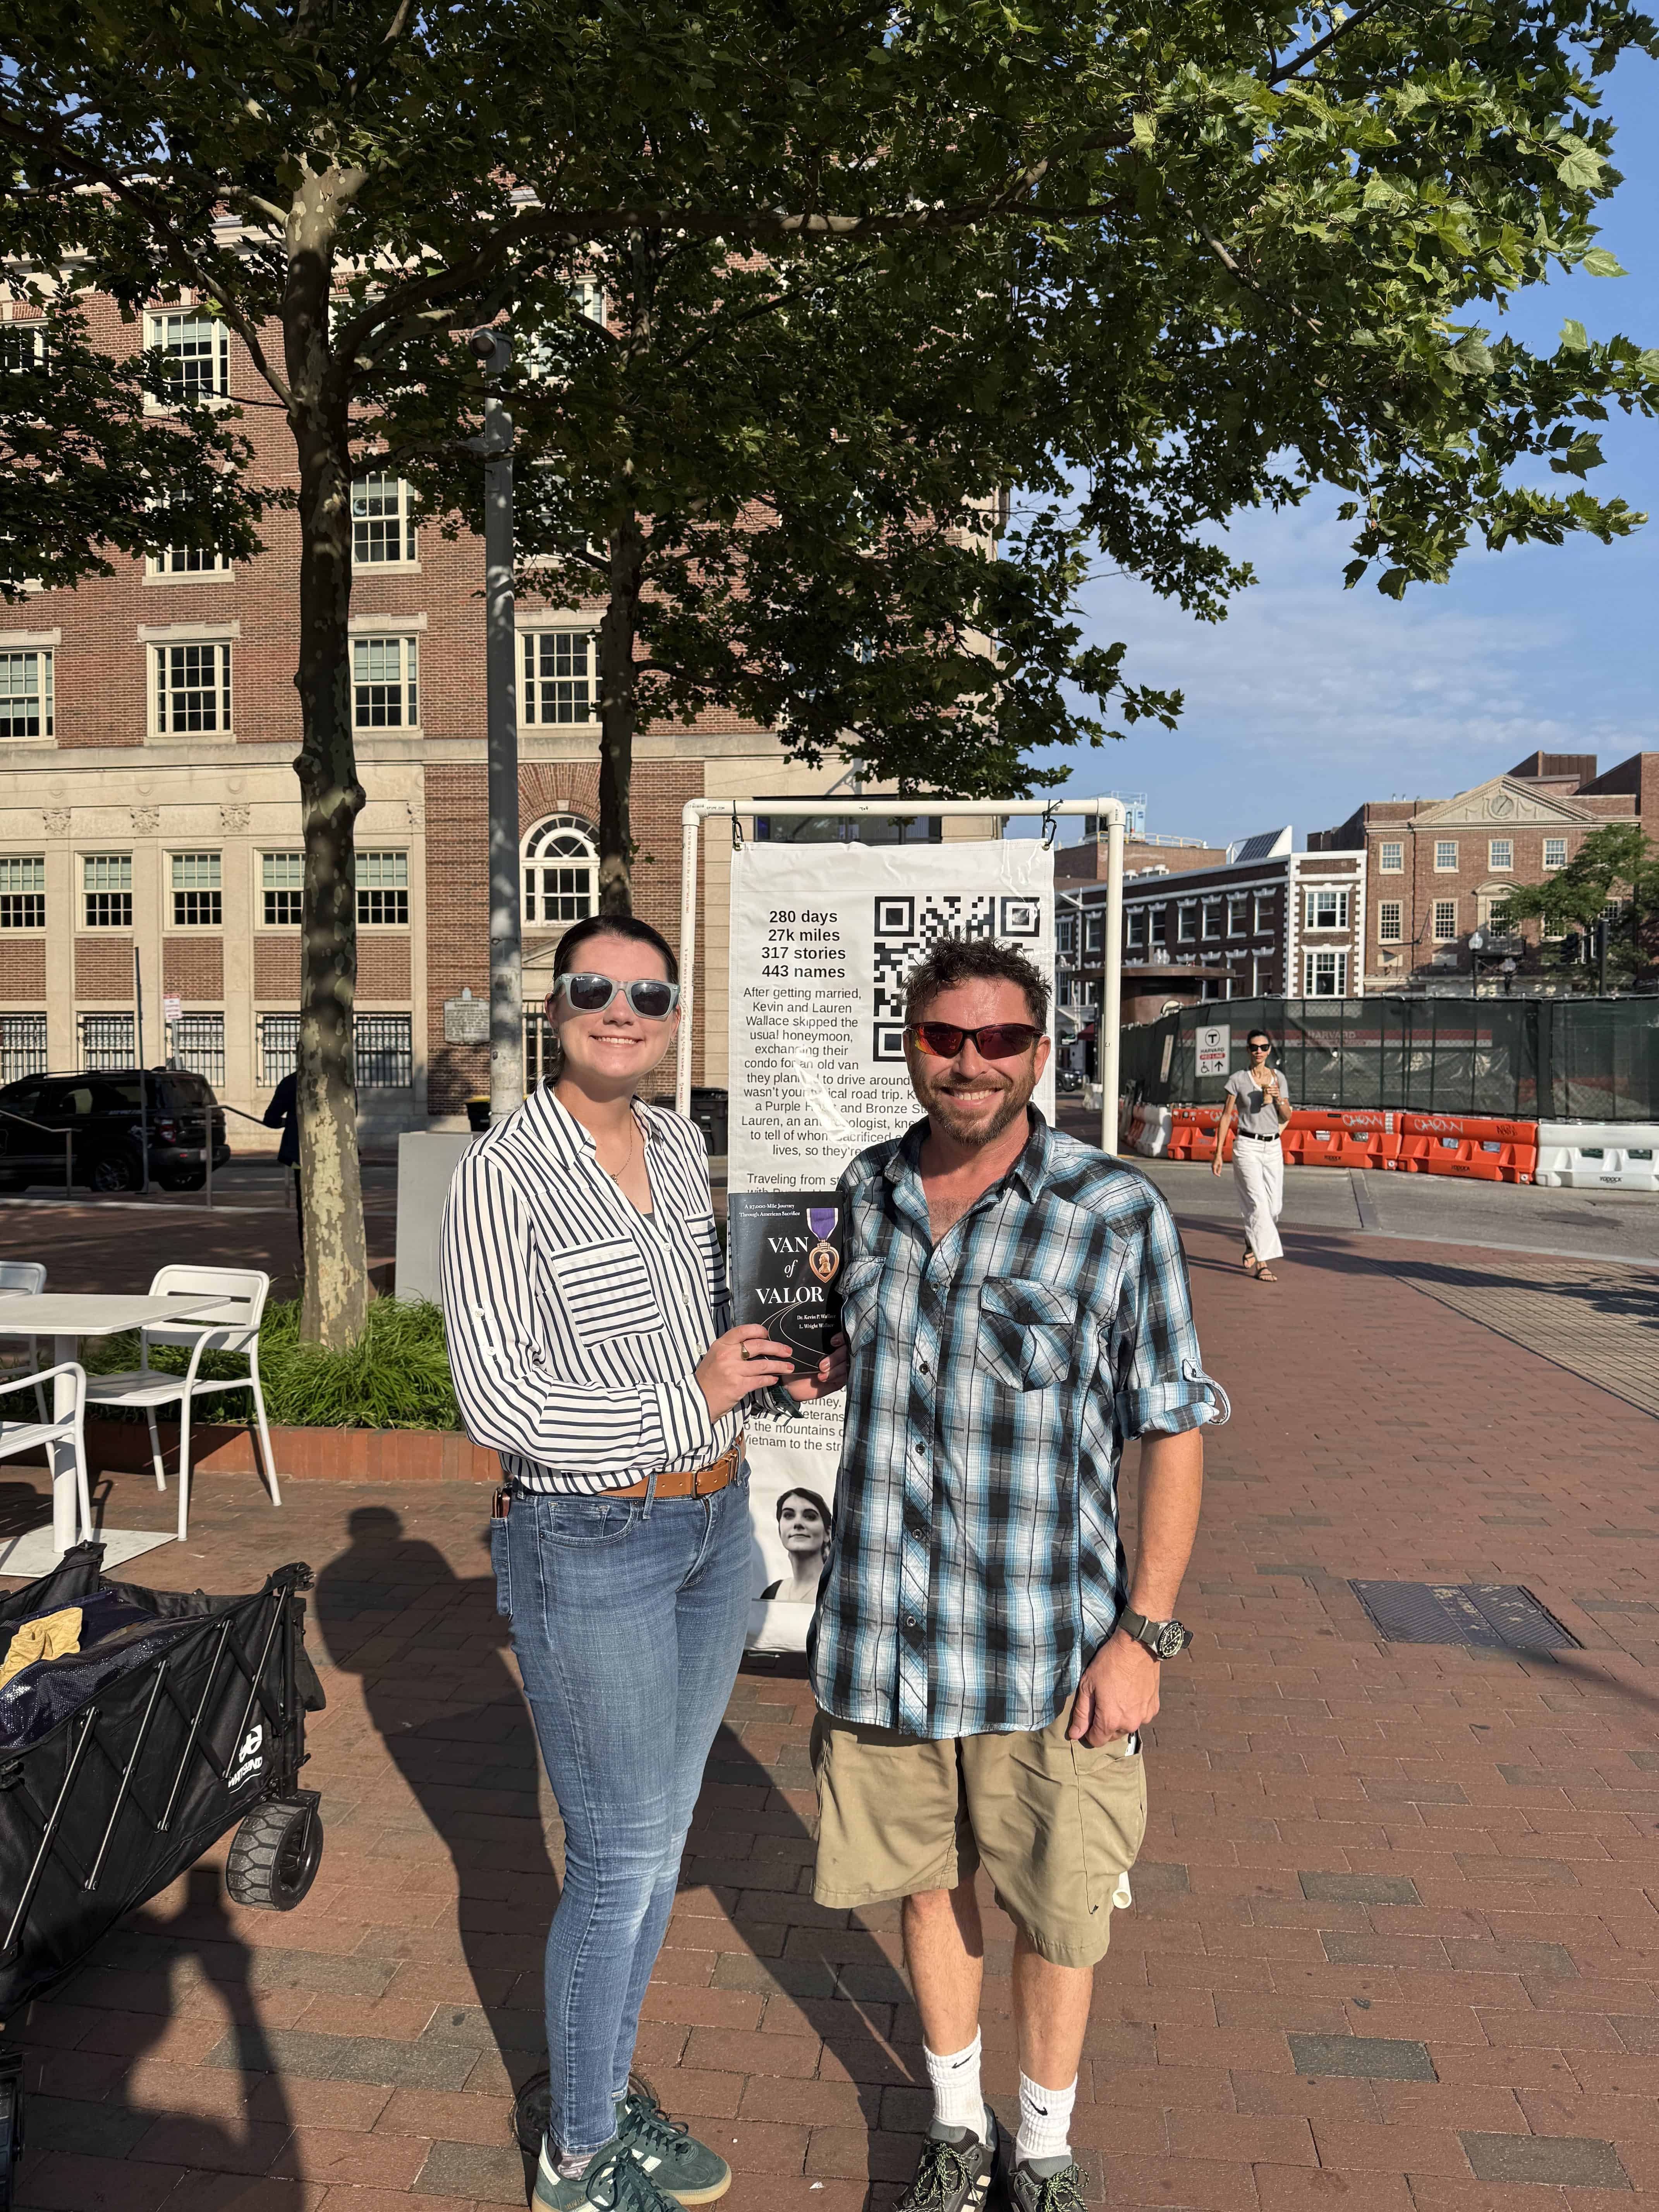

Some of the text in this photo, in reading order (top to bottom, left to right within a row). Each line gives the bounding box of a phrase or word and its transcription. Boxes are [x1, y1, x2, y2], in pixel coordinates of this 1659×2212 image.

[770, 910, 837, 926] 280 days
[768, 929, 840, 941] 27k miles
[762, 946, 845, 959] 317 stories
[762, 965, 845, 977] 443 names
[744, 987, 861, 1000] After getting married,
[753, 1001, 851, 1013] Kevin and Lauren
[746, 1015, 858, 1029] Wallace skipped the
[750, 1030, 852, 1043] usual honeymoon,
[1208, 1034, 1217, 1043] T
[823, 1045, 848, 1055] their
[745, 1058, 777, 1068] condo
[781, 1058, 795, 1067] for
[818, 1060, 834, 1069] old
[747, 1073, 770, 1085] they
[823, 1075, 833, 1084] to
[837, 1074, 865, 1084] drive
[870, 1075, 910, 1085] around
[744, 1087, 779, 1097] wasn't
[782, 1089, 804, 1099] your
[852, 1089, 877, 1099] road
[882, 1089, 903, 1102] trip.
[766, 1101, 800, 1113] Purple
[841, 1103, 861, 1113] and
[866, 1104, 907, 1113] Bronze
[742, 1116, 783, 1127] Lauren,
[751, 1131, 761, 1140] to
[765, 1130, 780, 1140] tell
[784, 1130, 794, 1140] of
[773, 1144, 800, 1156] lives,
[823, 1145, 861, 1158] they're
[747, 1173, 796, 1187] Traveling
[801, 1174, 825, 1185] from
[768, 1237, 809, 1253] VAN
[785, 1260, 798, 1278] of
[756, 1286, 824, 1304] VALOR
[802, 1398, 841, 1410] ourney.
[800, 1410, 844, 1422] eterans
[754, 1421, 771, 1432] the
[776, 1423, 835, 1436] mountains
[790, 1439, 800, 1449] to
[804, 1439, 822, 1450] the
